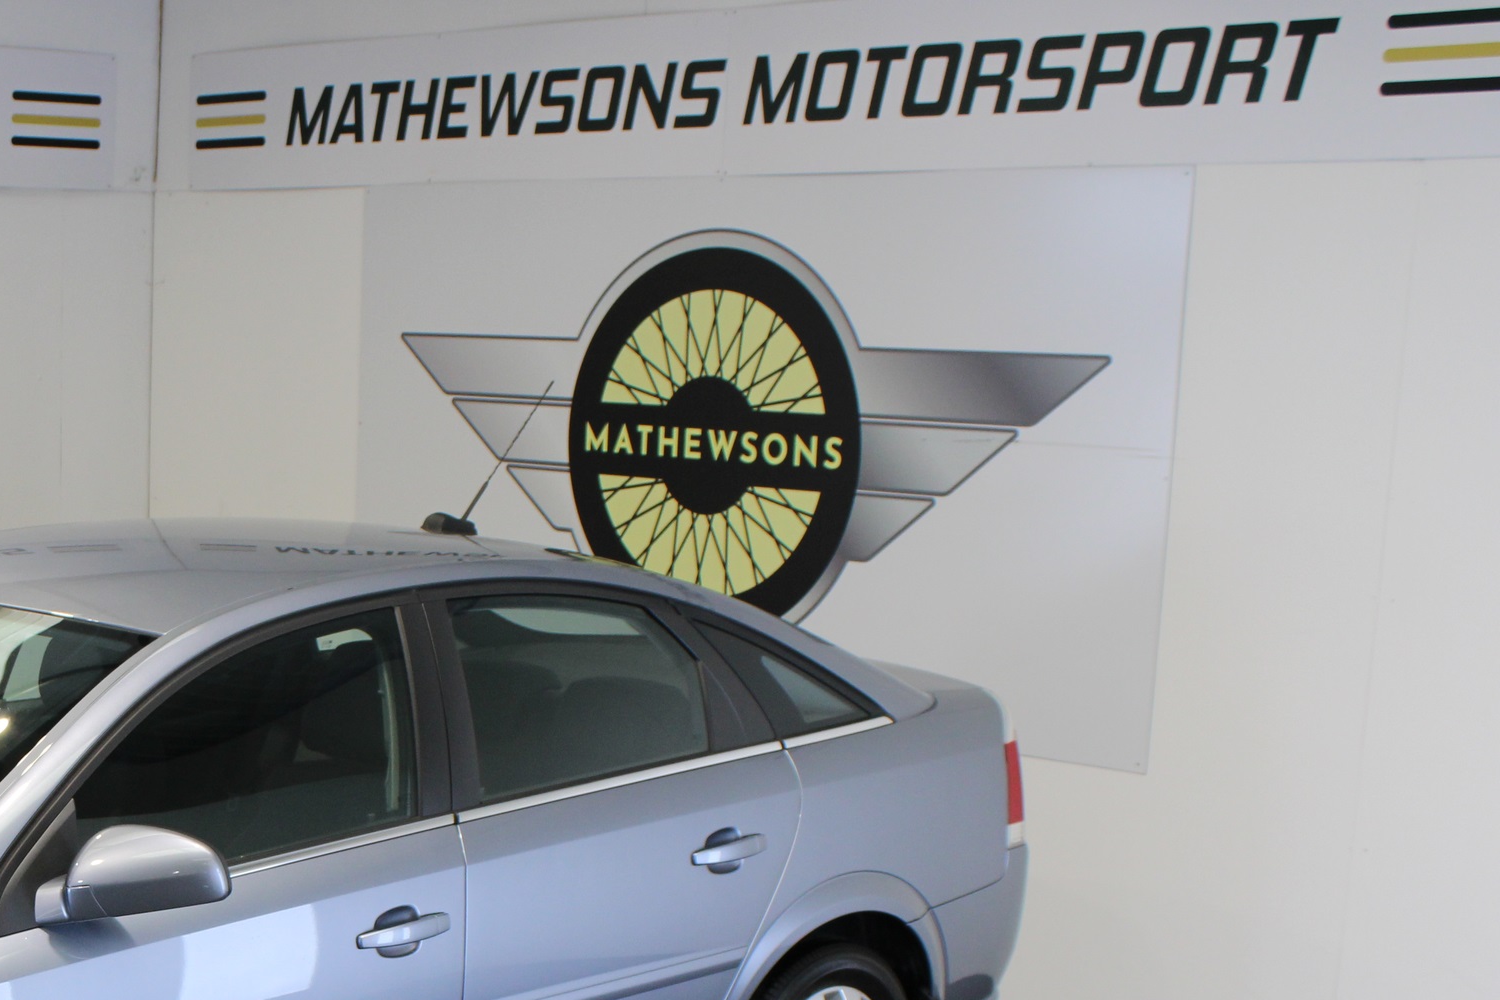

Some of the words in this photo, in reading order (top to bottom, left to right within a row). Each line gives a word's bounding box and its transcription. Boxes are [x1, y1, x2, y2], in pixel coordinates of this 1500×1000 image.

[285, 59, 727, 147] MATHEWSONS
[742, 17, 1341, 125] MOTORSPORT
[585, 422, 843, 471] MATHEWSONS
